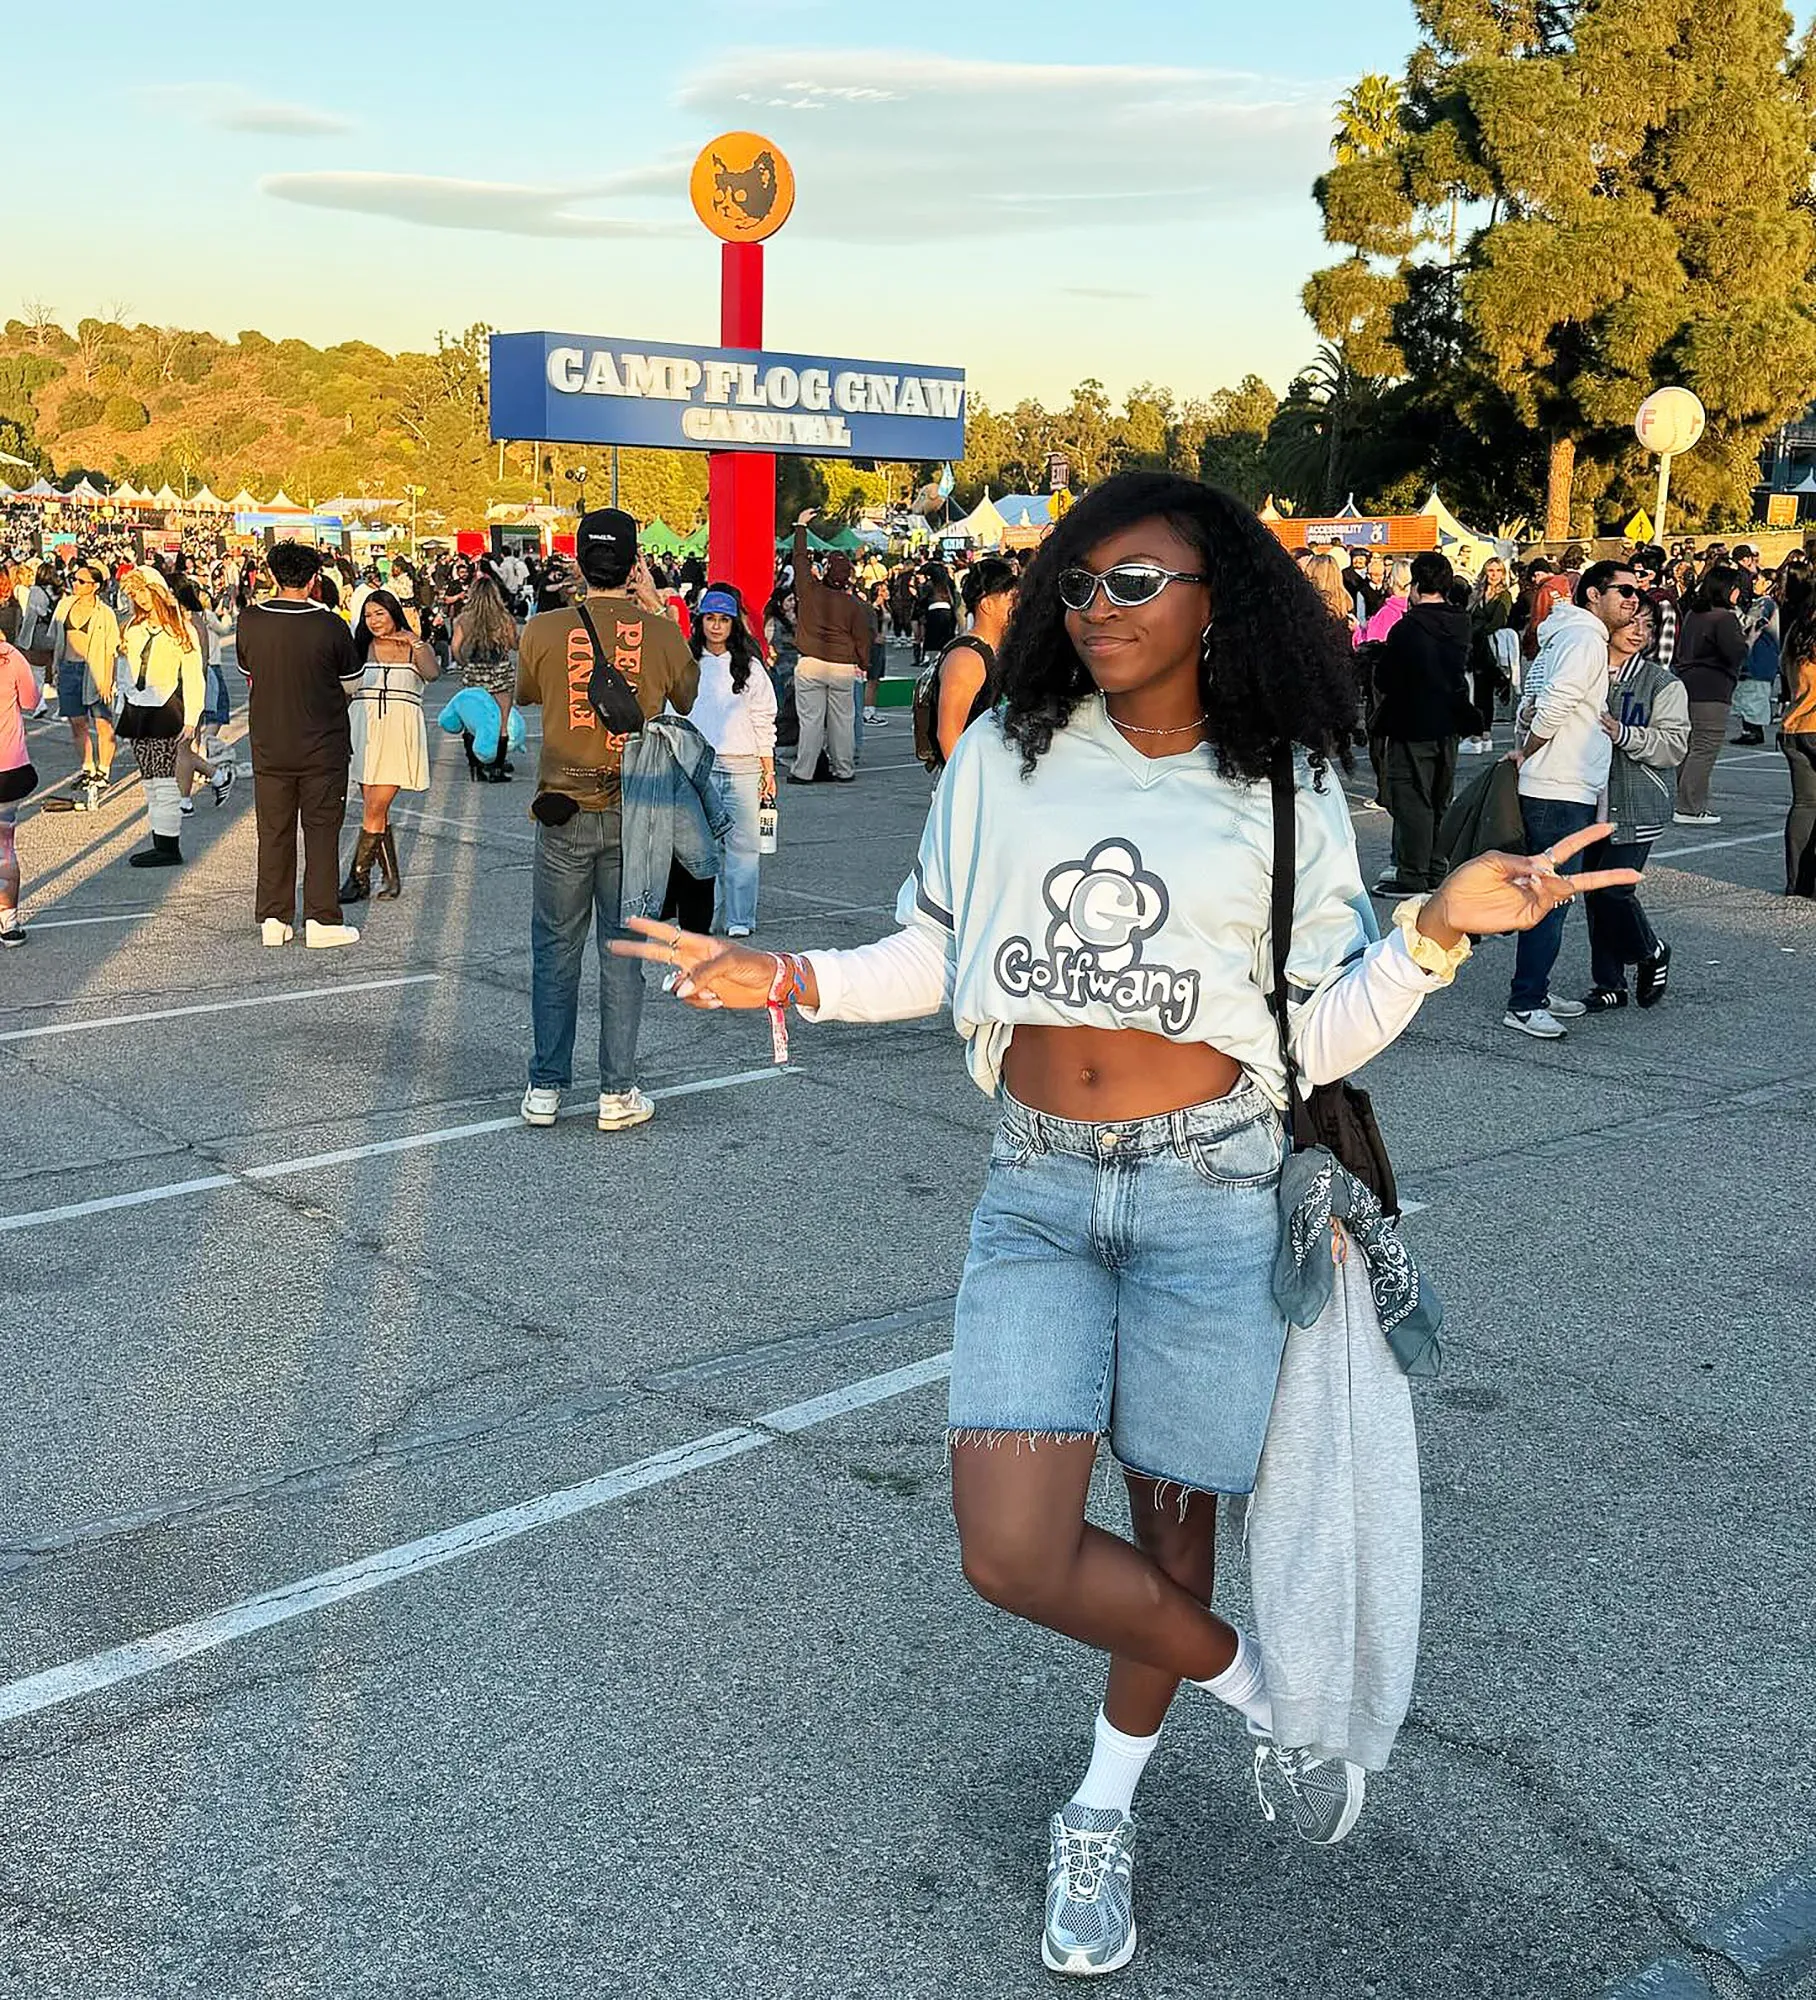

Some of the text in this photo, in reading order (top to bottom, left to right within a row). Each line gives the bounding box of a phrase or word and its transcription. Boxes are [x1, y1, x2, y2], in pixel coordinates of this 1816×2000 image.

[546, 346, 966, 418] CAMP FLOG GNAW
[682, 406, 851, 448] CARNIVAL
[1307, 525, 1363, 534] ACCESSIBILITY
[1621, 691, 1649, 727] LA
[994, 935, 1201, 1035] Golfwang
